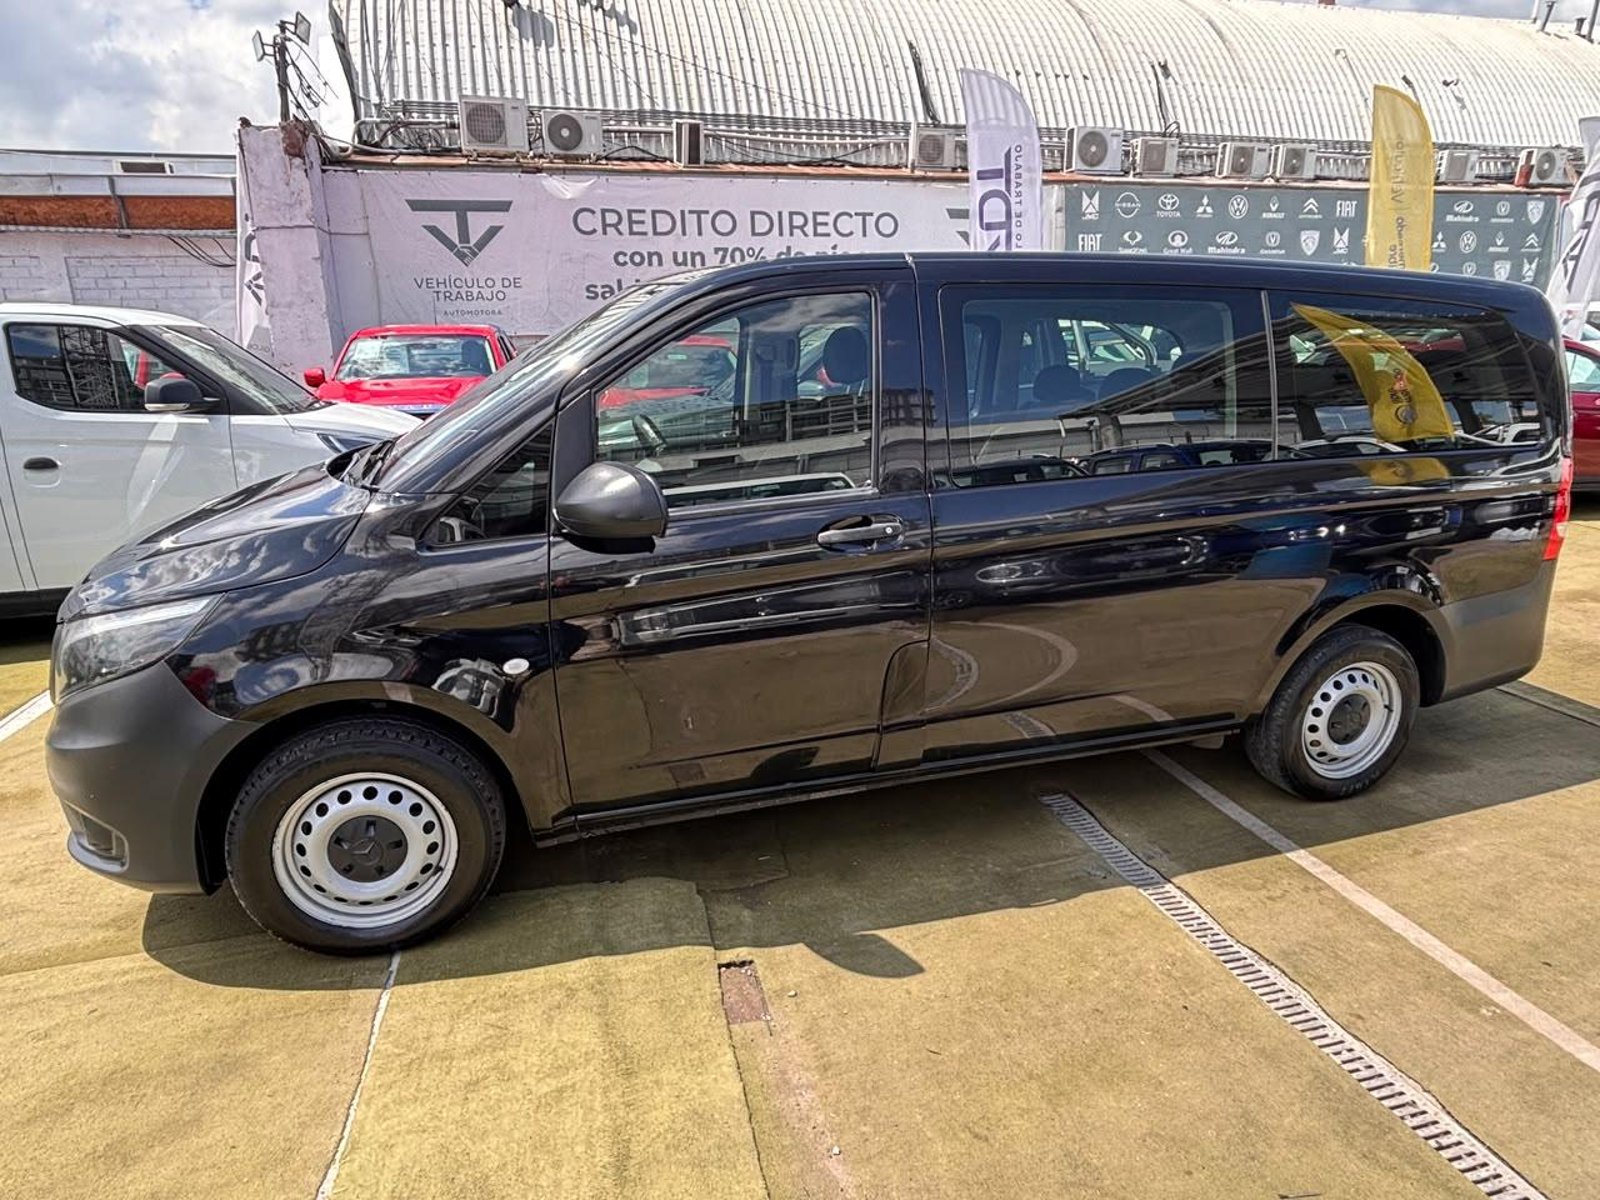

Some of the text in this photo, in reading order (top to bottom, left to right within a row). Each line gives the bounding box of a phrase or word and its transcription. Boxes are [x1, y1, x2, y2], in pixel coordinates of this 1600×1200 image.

[1336, 201, 1357, 217] FIAT
[572, 207, 899, 238] CREDITO DIRECTO
[1078, 234, 1102, 252] FIAT
[1208, 246, 1245, 254] Mahindra
[613, 250, 663, 267] con
[672, 250, 706, 268] un
[414, 274, 522, 290] VEHÍCULO DE
[433, 290, 507, 302] TRABAJO
[443, 309, 503, 317] AUTOMOTORA
